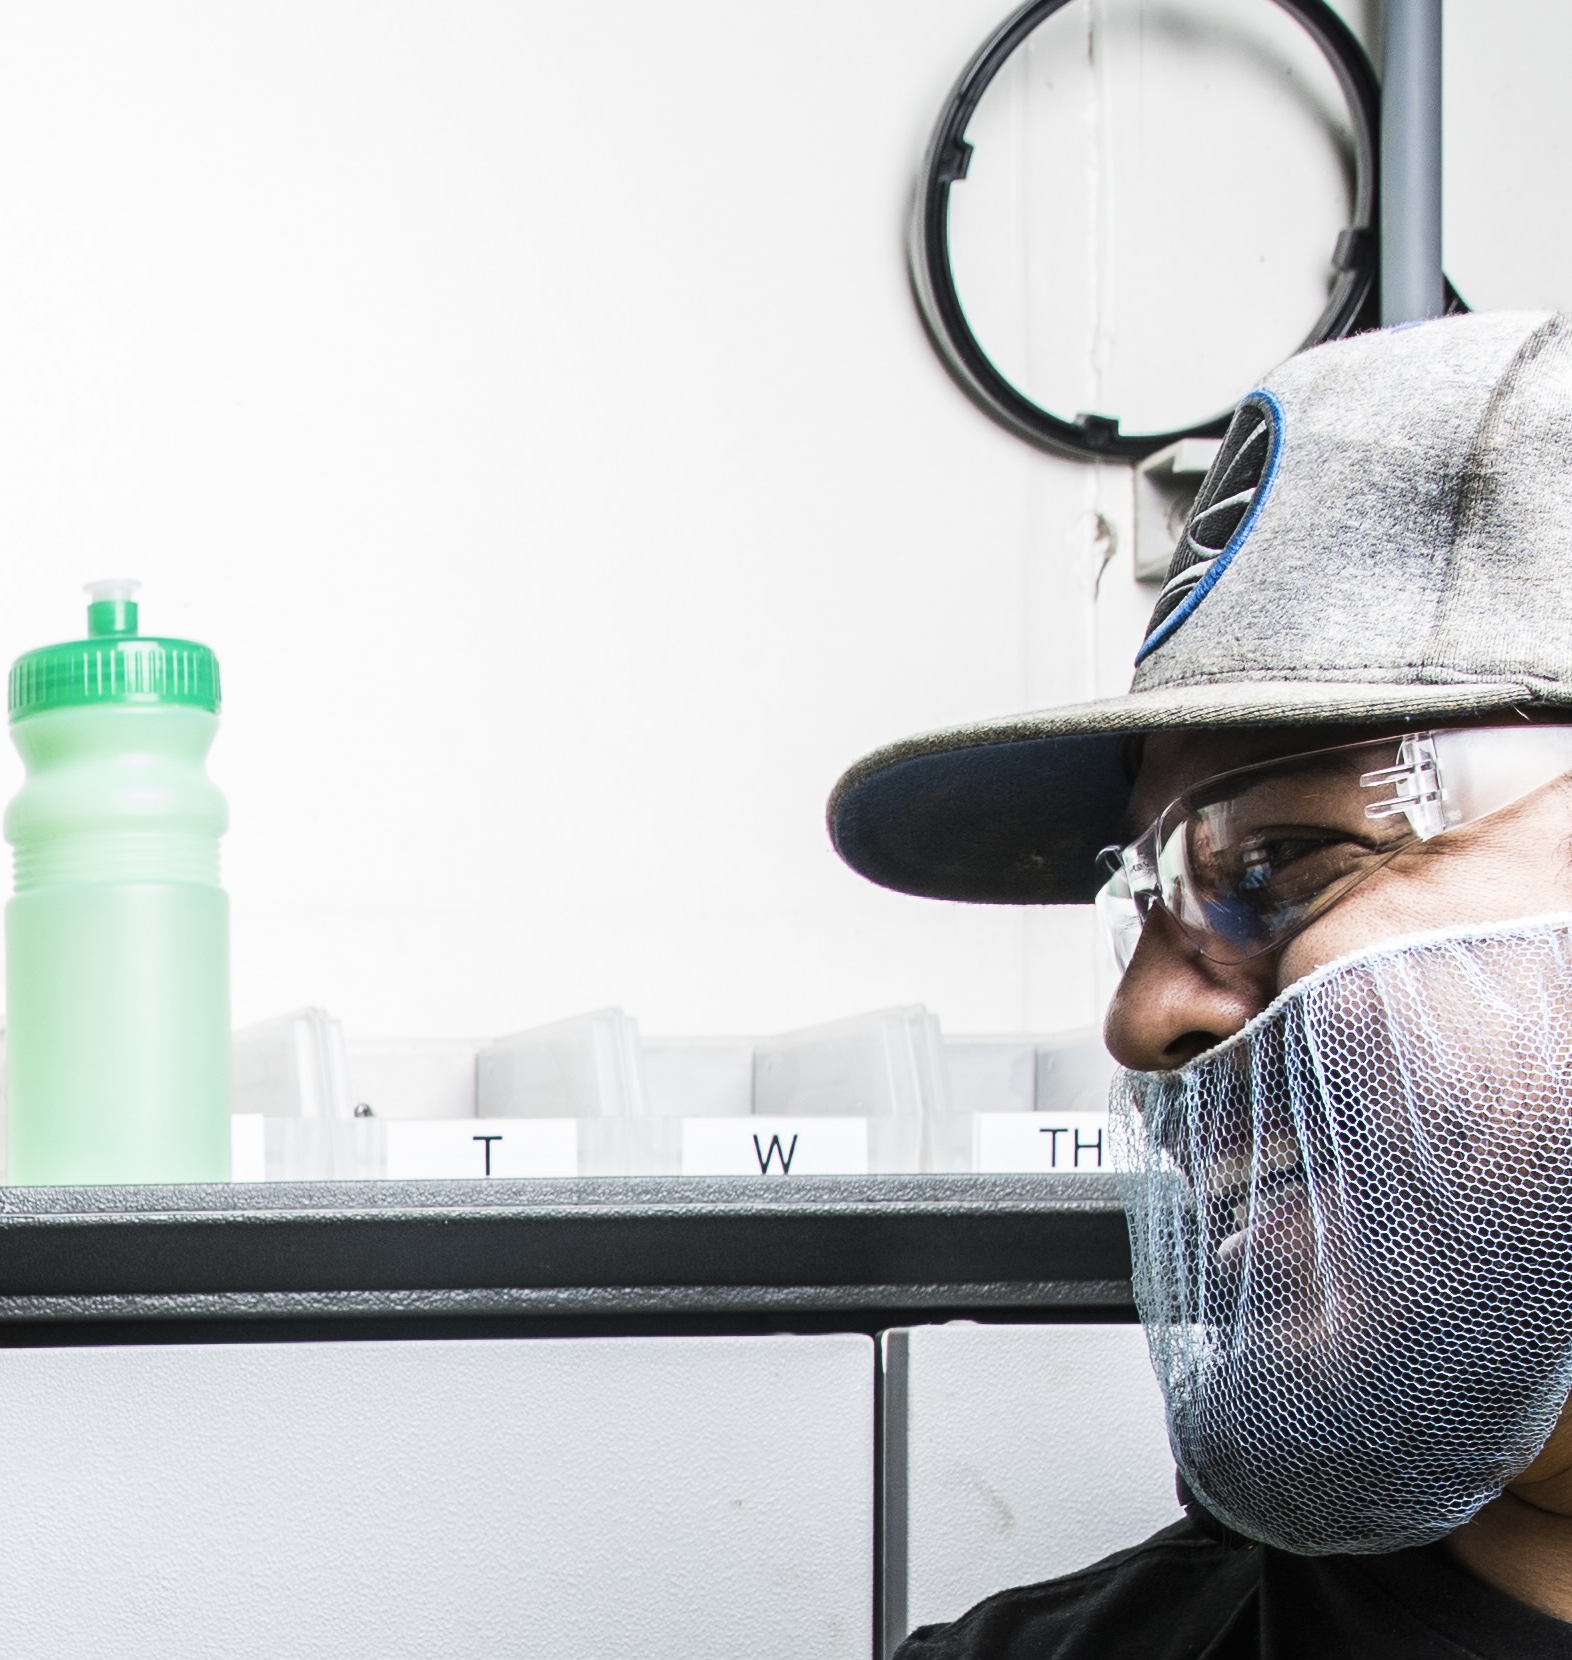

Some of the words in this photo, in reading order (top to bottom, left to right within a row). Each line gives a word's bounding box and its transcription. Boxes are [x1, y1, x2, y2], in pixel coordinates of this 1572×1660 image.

[473, 1135, 503, 1176] T
[753, 1133, 798, 1175] W
[1039, 1128, 1103, 1168] TH
